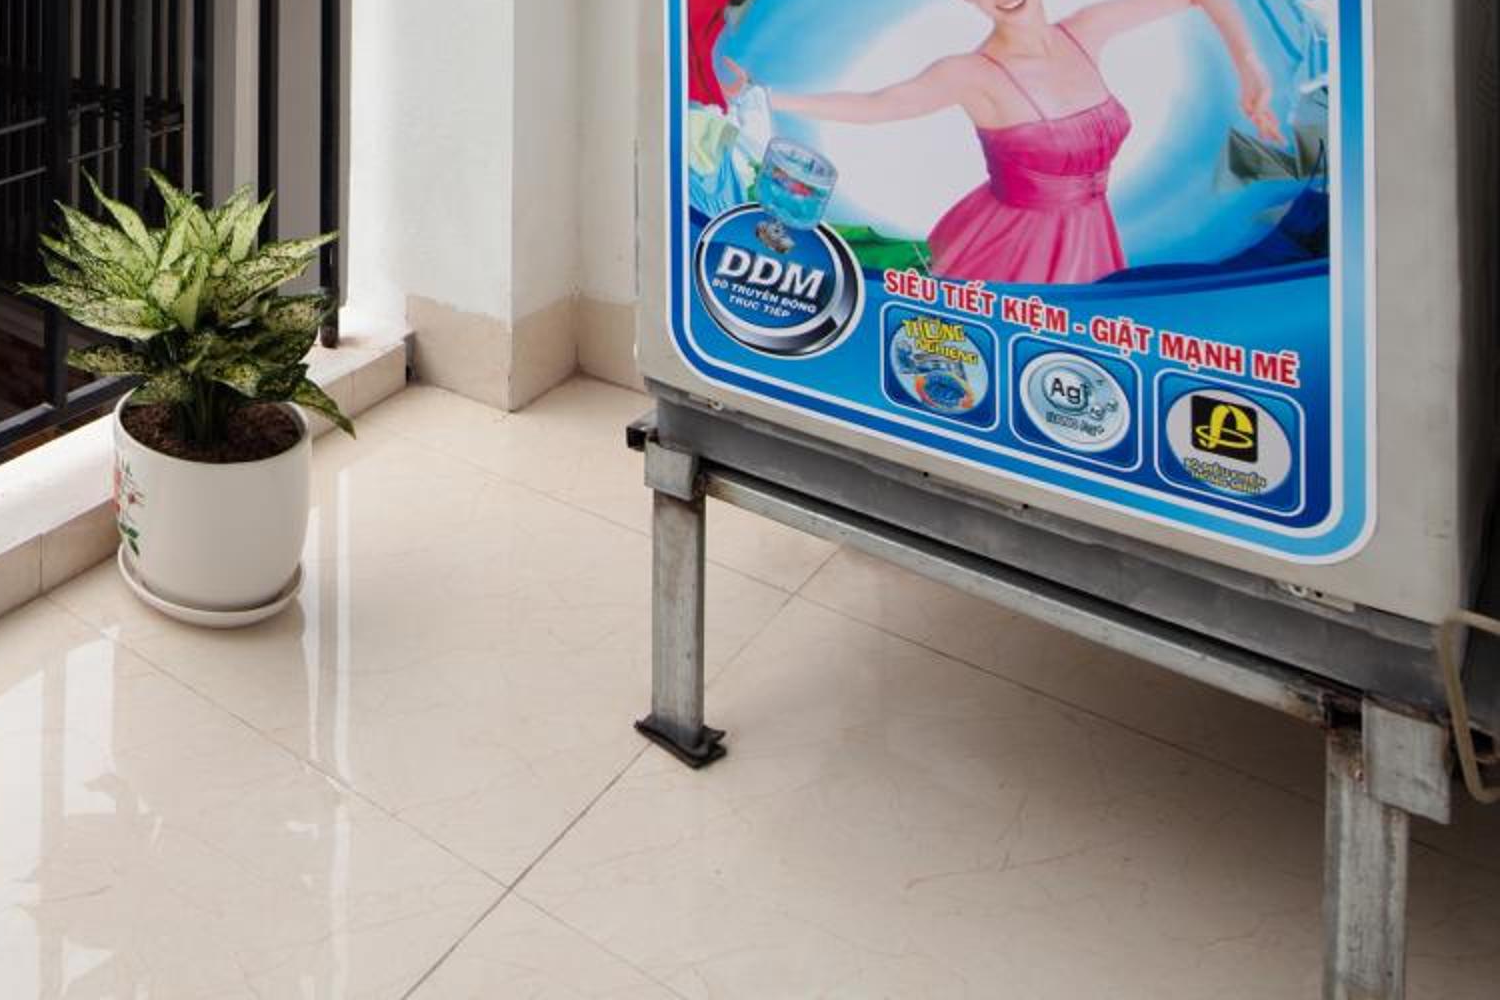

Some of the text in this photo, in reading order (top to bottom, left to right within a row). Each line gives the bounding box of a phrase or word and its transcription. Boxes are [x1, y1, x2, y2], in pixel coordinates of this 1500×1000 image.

[715, 245, 825, 300] DDM
[885, 268, 936, 303] SIÊU
[942, 279, 996, 316] TIẾT
[1003, 297, 1067, 333] KIỆM
[1091, 315, 1151, 356] GIẶT
[1161, 333, 1243, 375] MẠNH
[1254, 352, 1300, 386] MẼ
